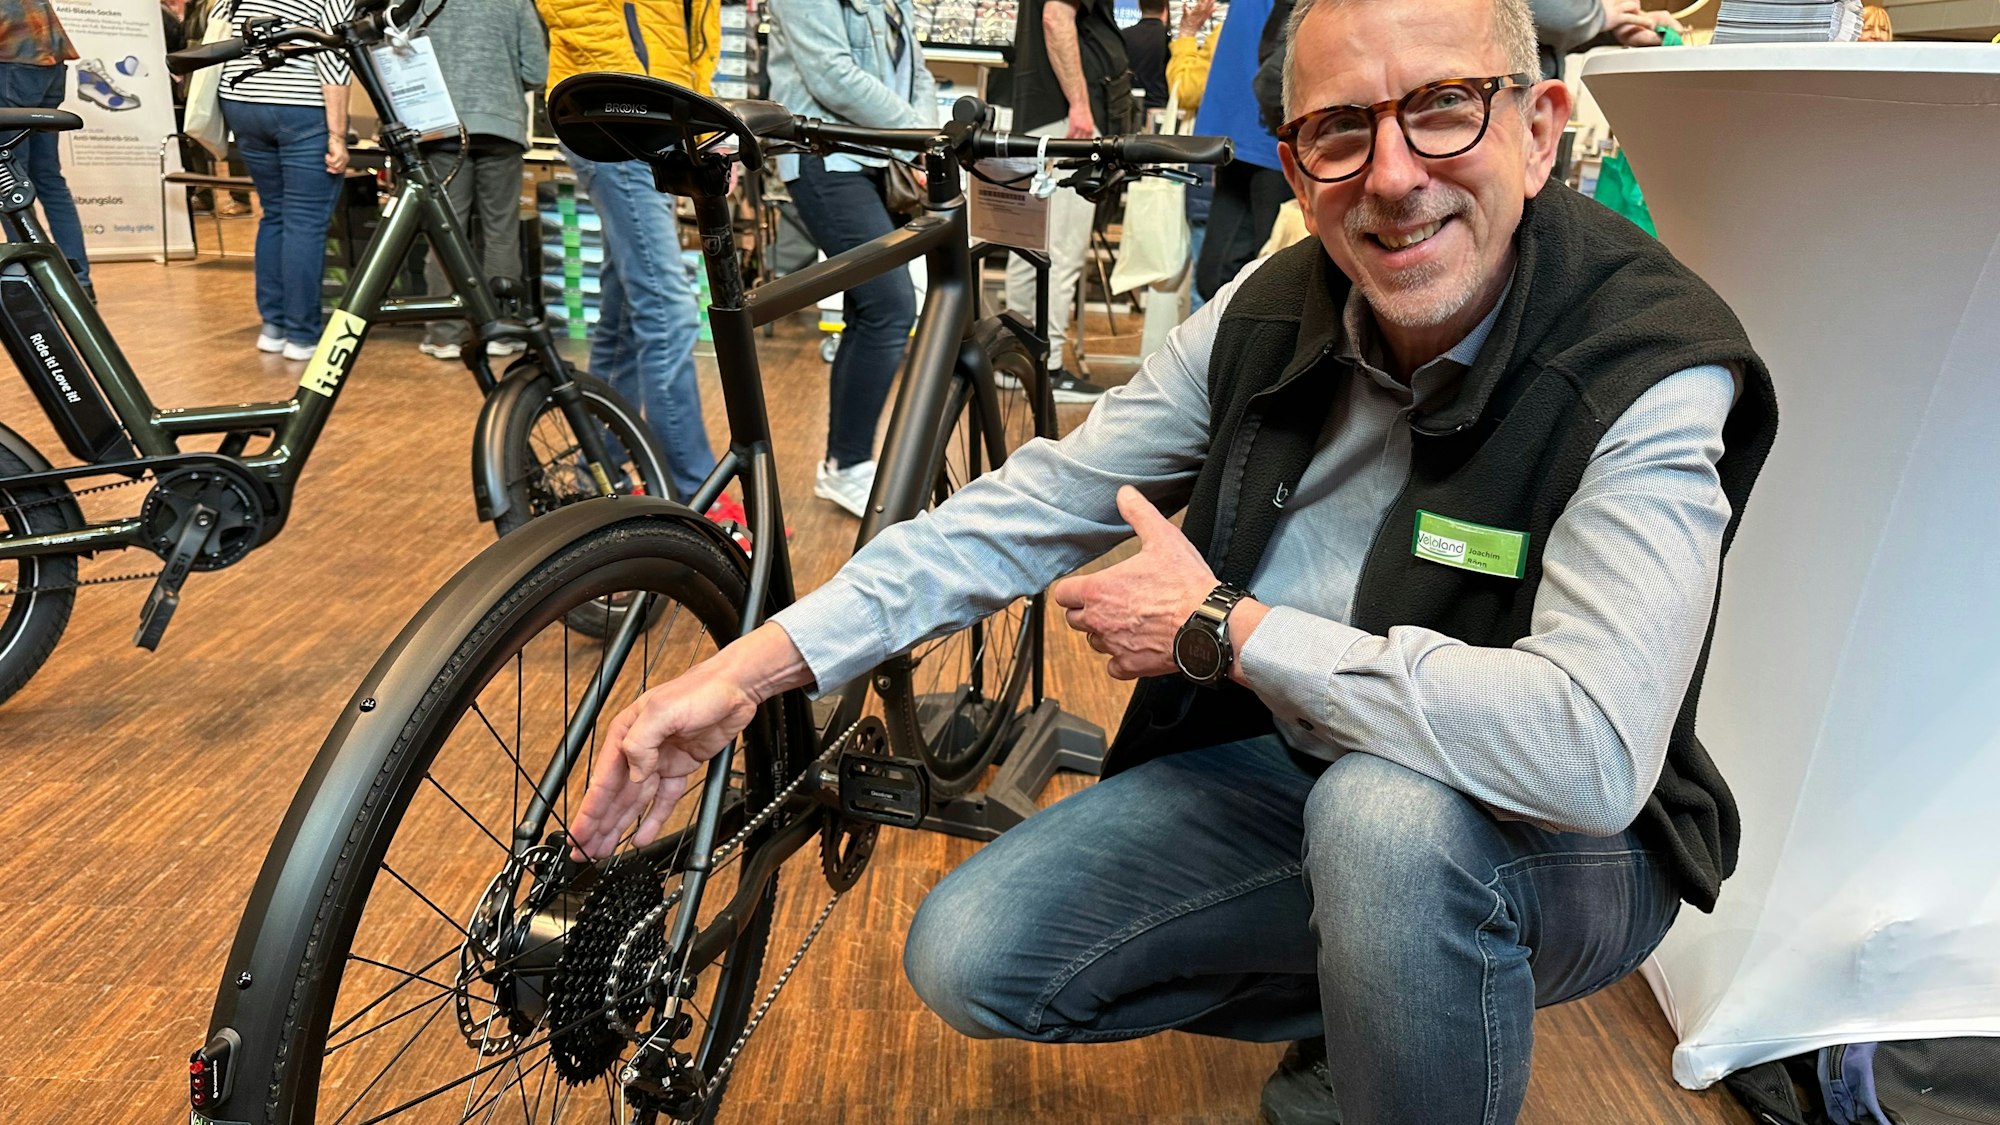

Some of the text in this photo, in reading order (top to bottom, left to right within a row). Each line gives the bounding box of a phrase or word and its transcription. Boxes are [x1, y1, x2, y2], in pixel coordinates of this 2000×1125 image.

[604, 102, 648, 115] BROOKS
[30, 333, 49, 357] Ride
[51, 369, 71, 392] Love
[1468, 548, 1500, 560] Joachim
